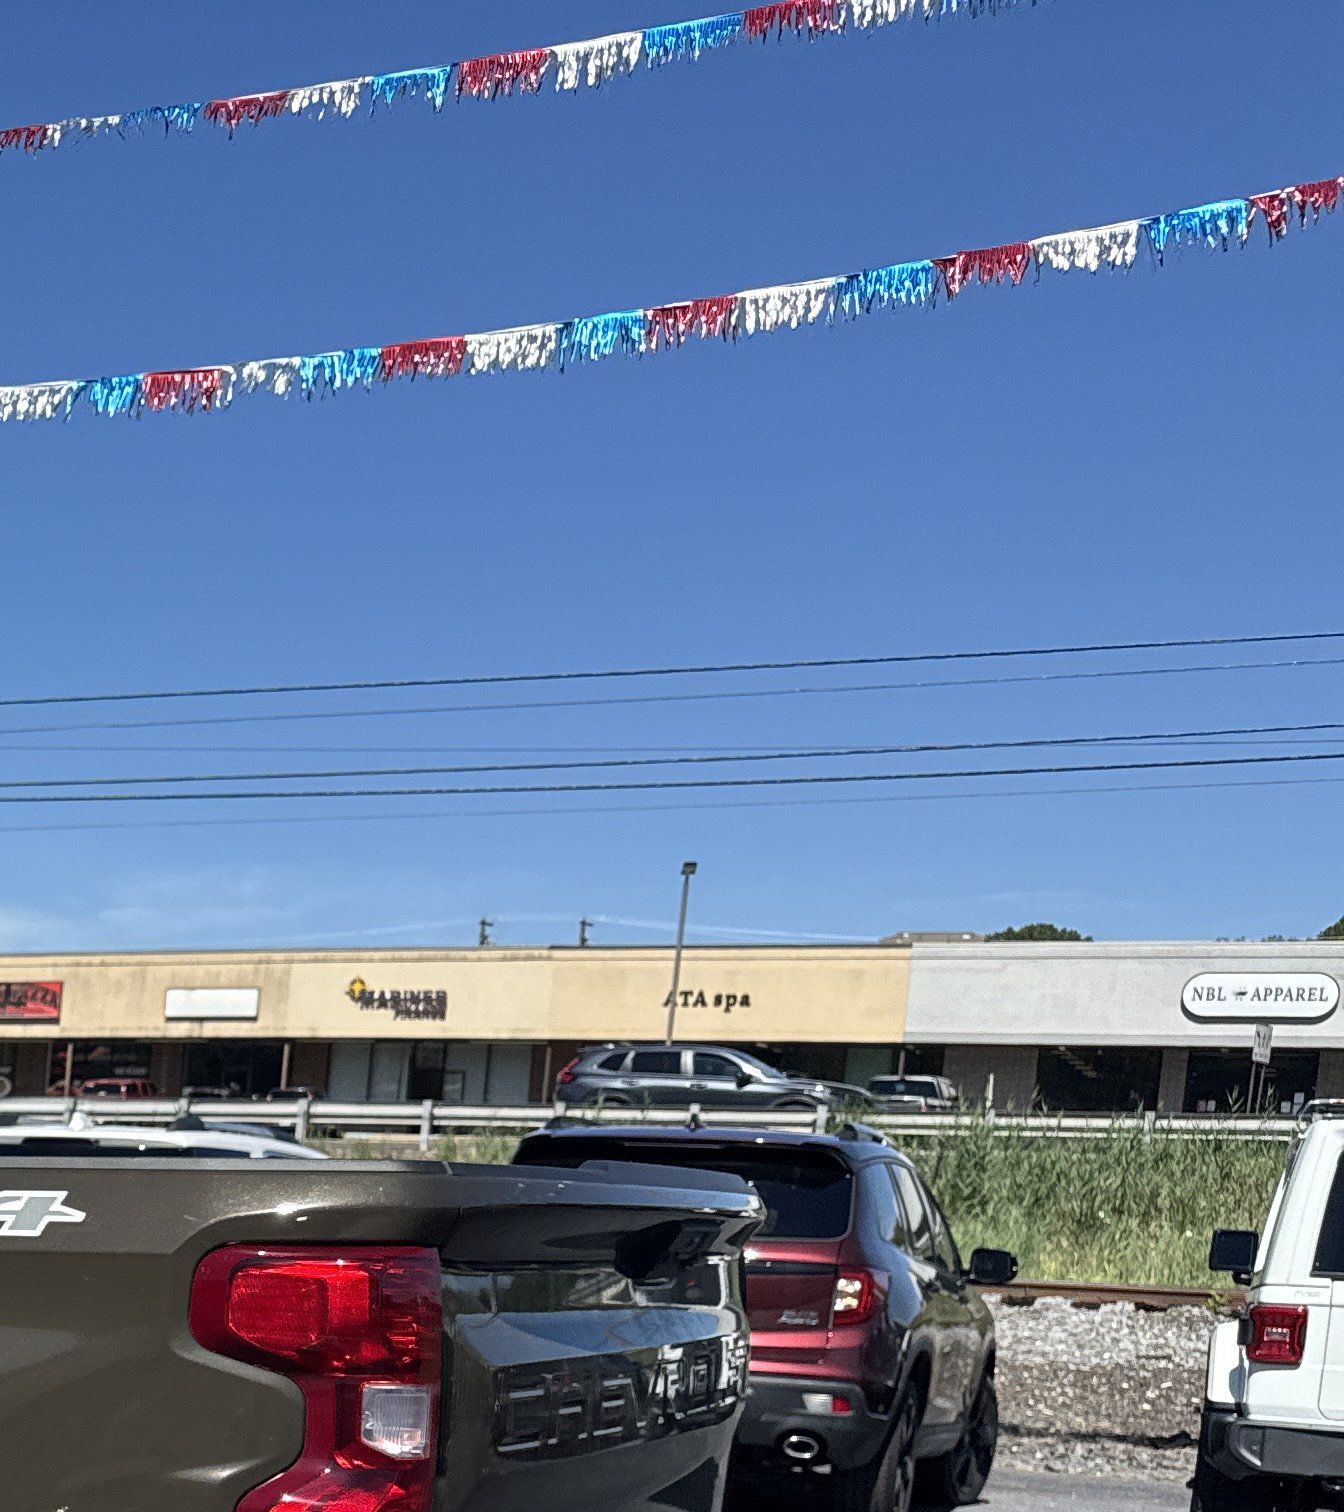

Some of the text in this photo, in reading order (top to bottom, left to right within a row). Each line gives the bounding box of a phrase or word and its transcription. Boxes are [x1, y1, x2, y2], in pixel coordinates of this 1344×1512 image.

[713, 993, 751, 1013] spa
[1192, 986, 1329, 1002] NBL APPAREL
